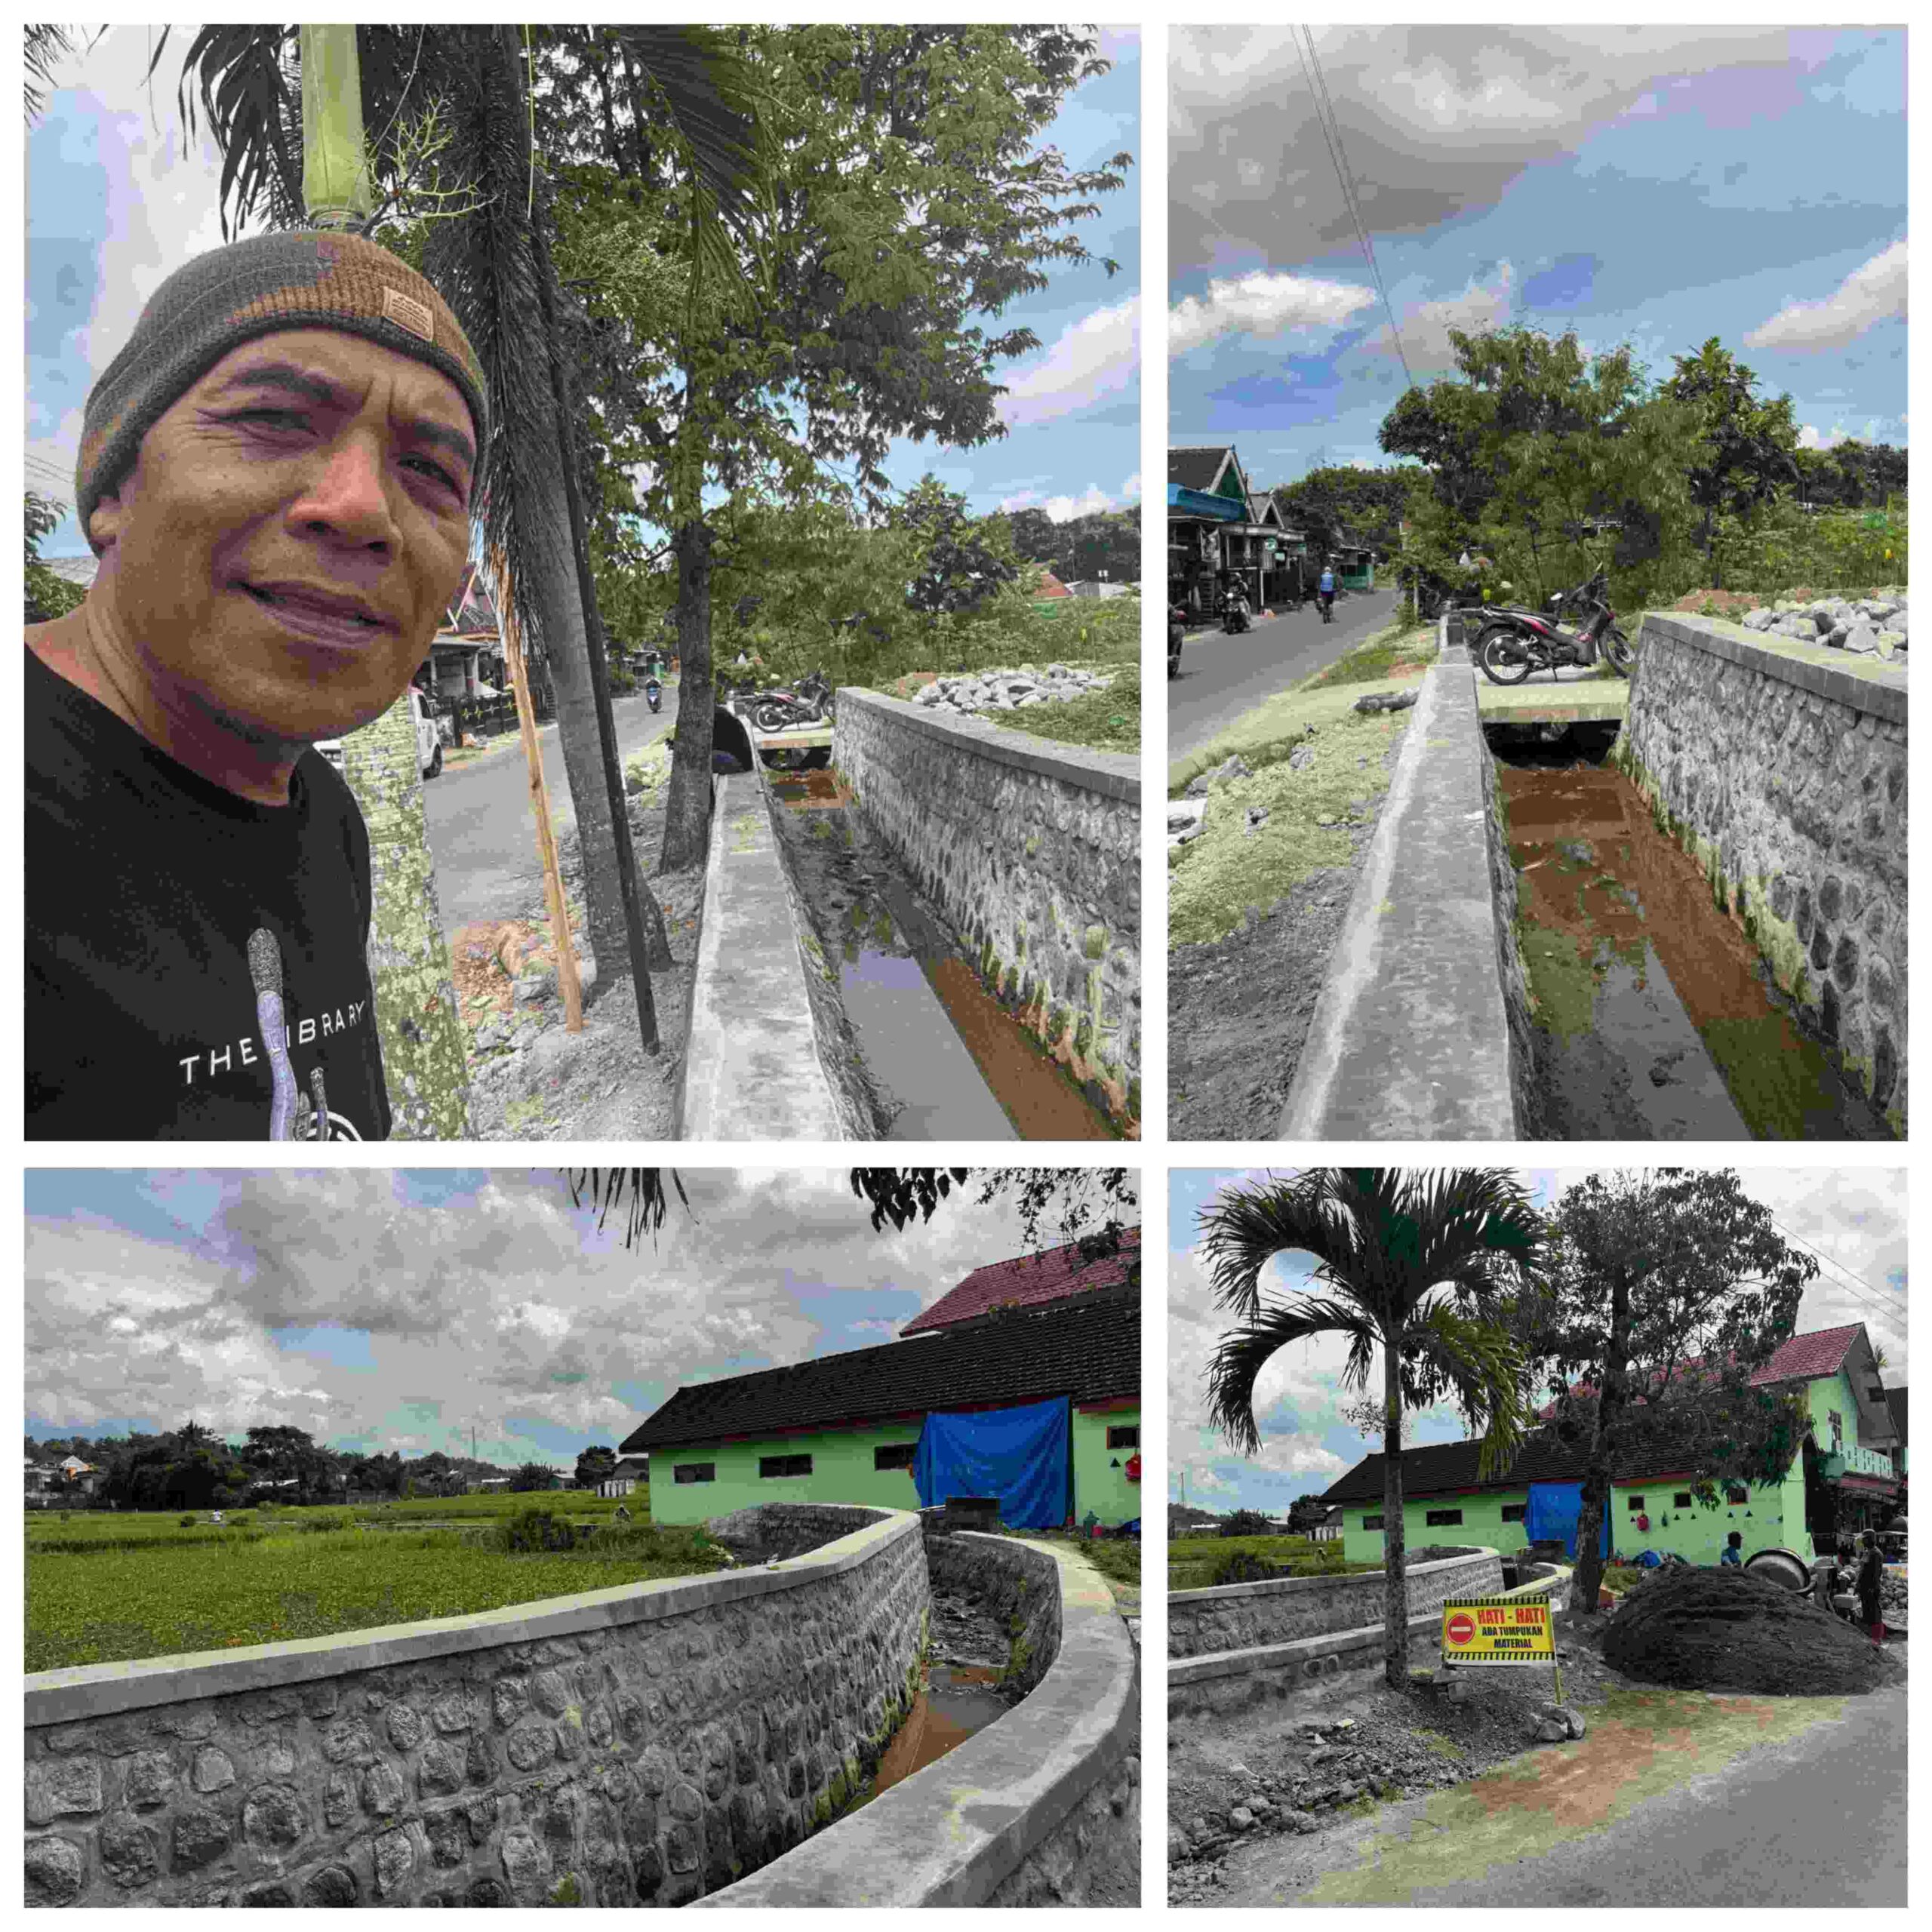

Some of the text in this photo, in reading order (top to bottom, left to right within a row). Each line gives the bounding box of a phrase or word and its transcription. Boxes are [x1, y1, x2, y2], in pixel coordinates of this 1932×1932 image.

[179, 1037, 257, 1084] THE
[1477, 1608, 1506, 1624] HATI
[1515, 1607, 1546, 1623] HATI
[1481, 1626, 1543, 1636] ADA TUMPUKAN
[1494, 1638, 1533, 1649] MATERIAL
